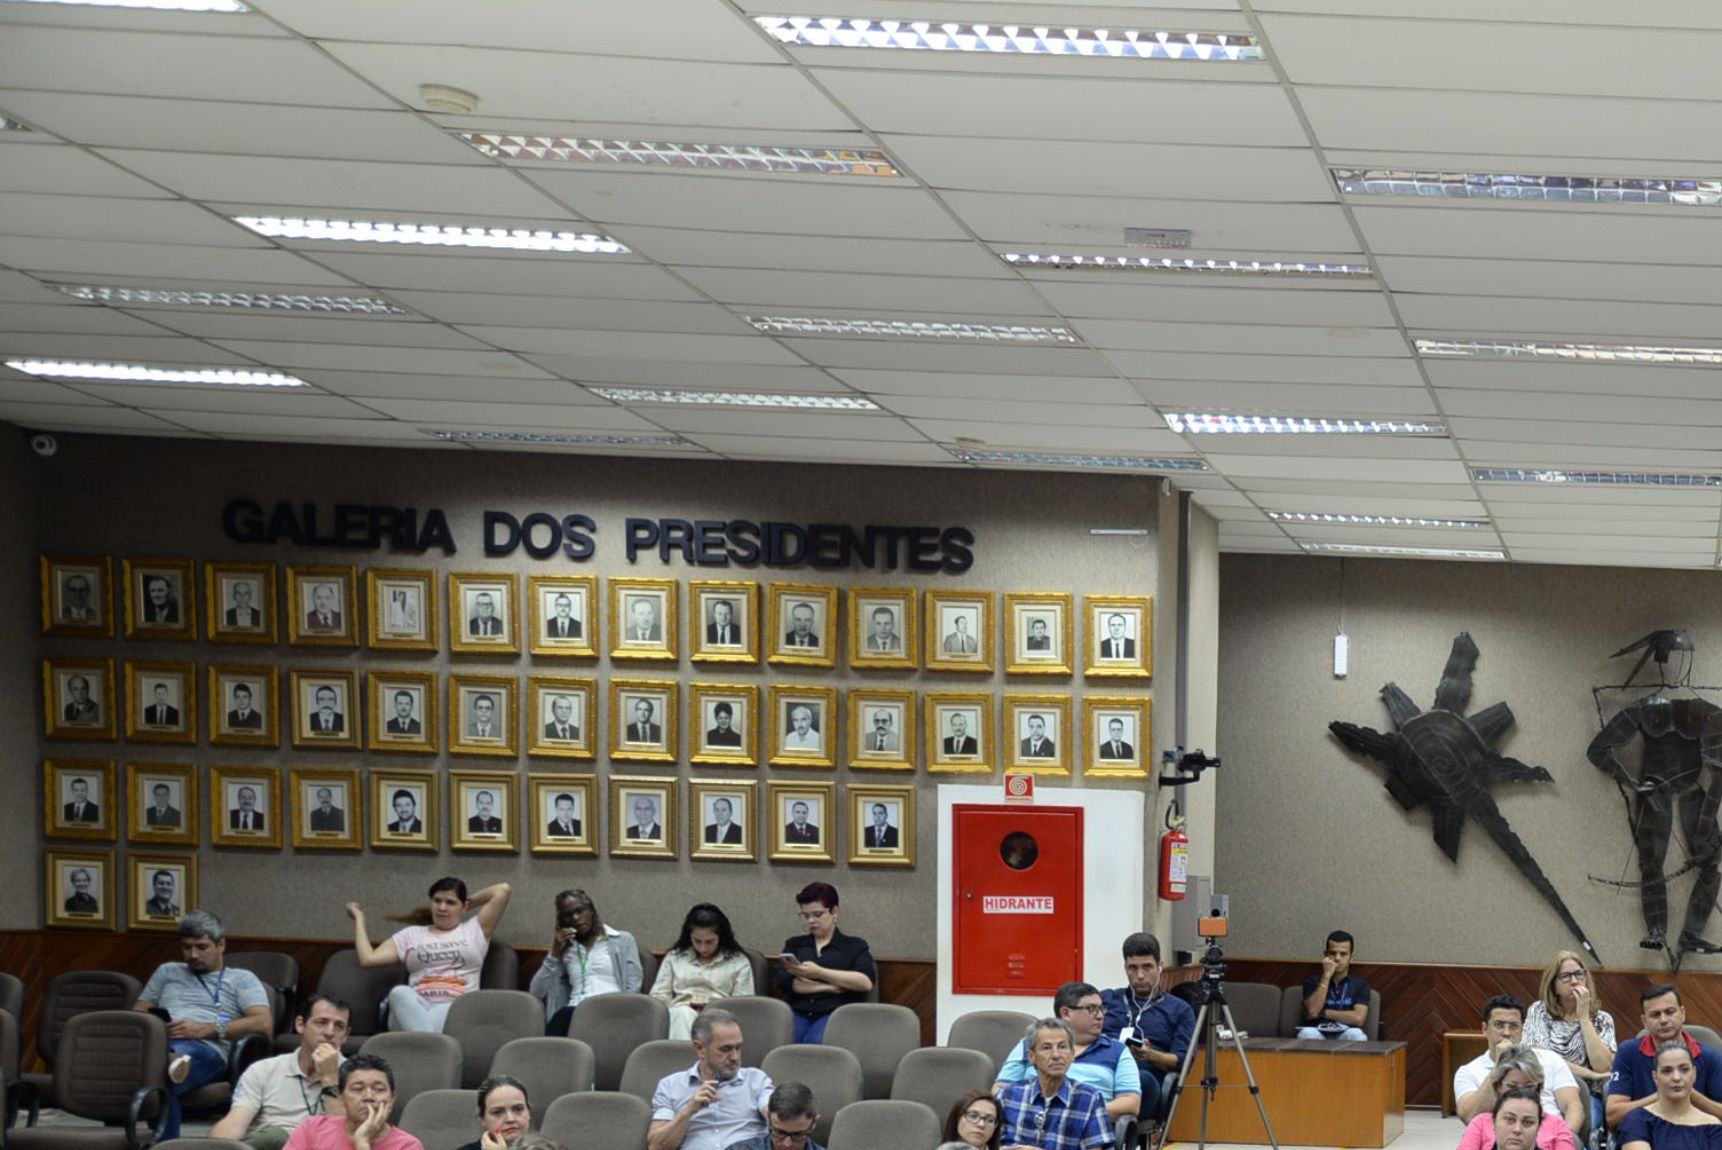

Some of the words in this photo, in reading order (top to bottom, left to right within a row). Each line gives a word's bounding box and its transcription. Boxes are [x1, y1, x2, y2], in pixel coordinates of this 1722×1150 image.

[222, 499, 457, 557] GALERIA
[483, 510, 597, 561] DOS
[625, 517, 975, 573] PRESIDENTES
[985, 897, 1053, 910] HIDRANTE
